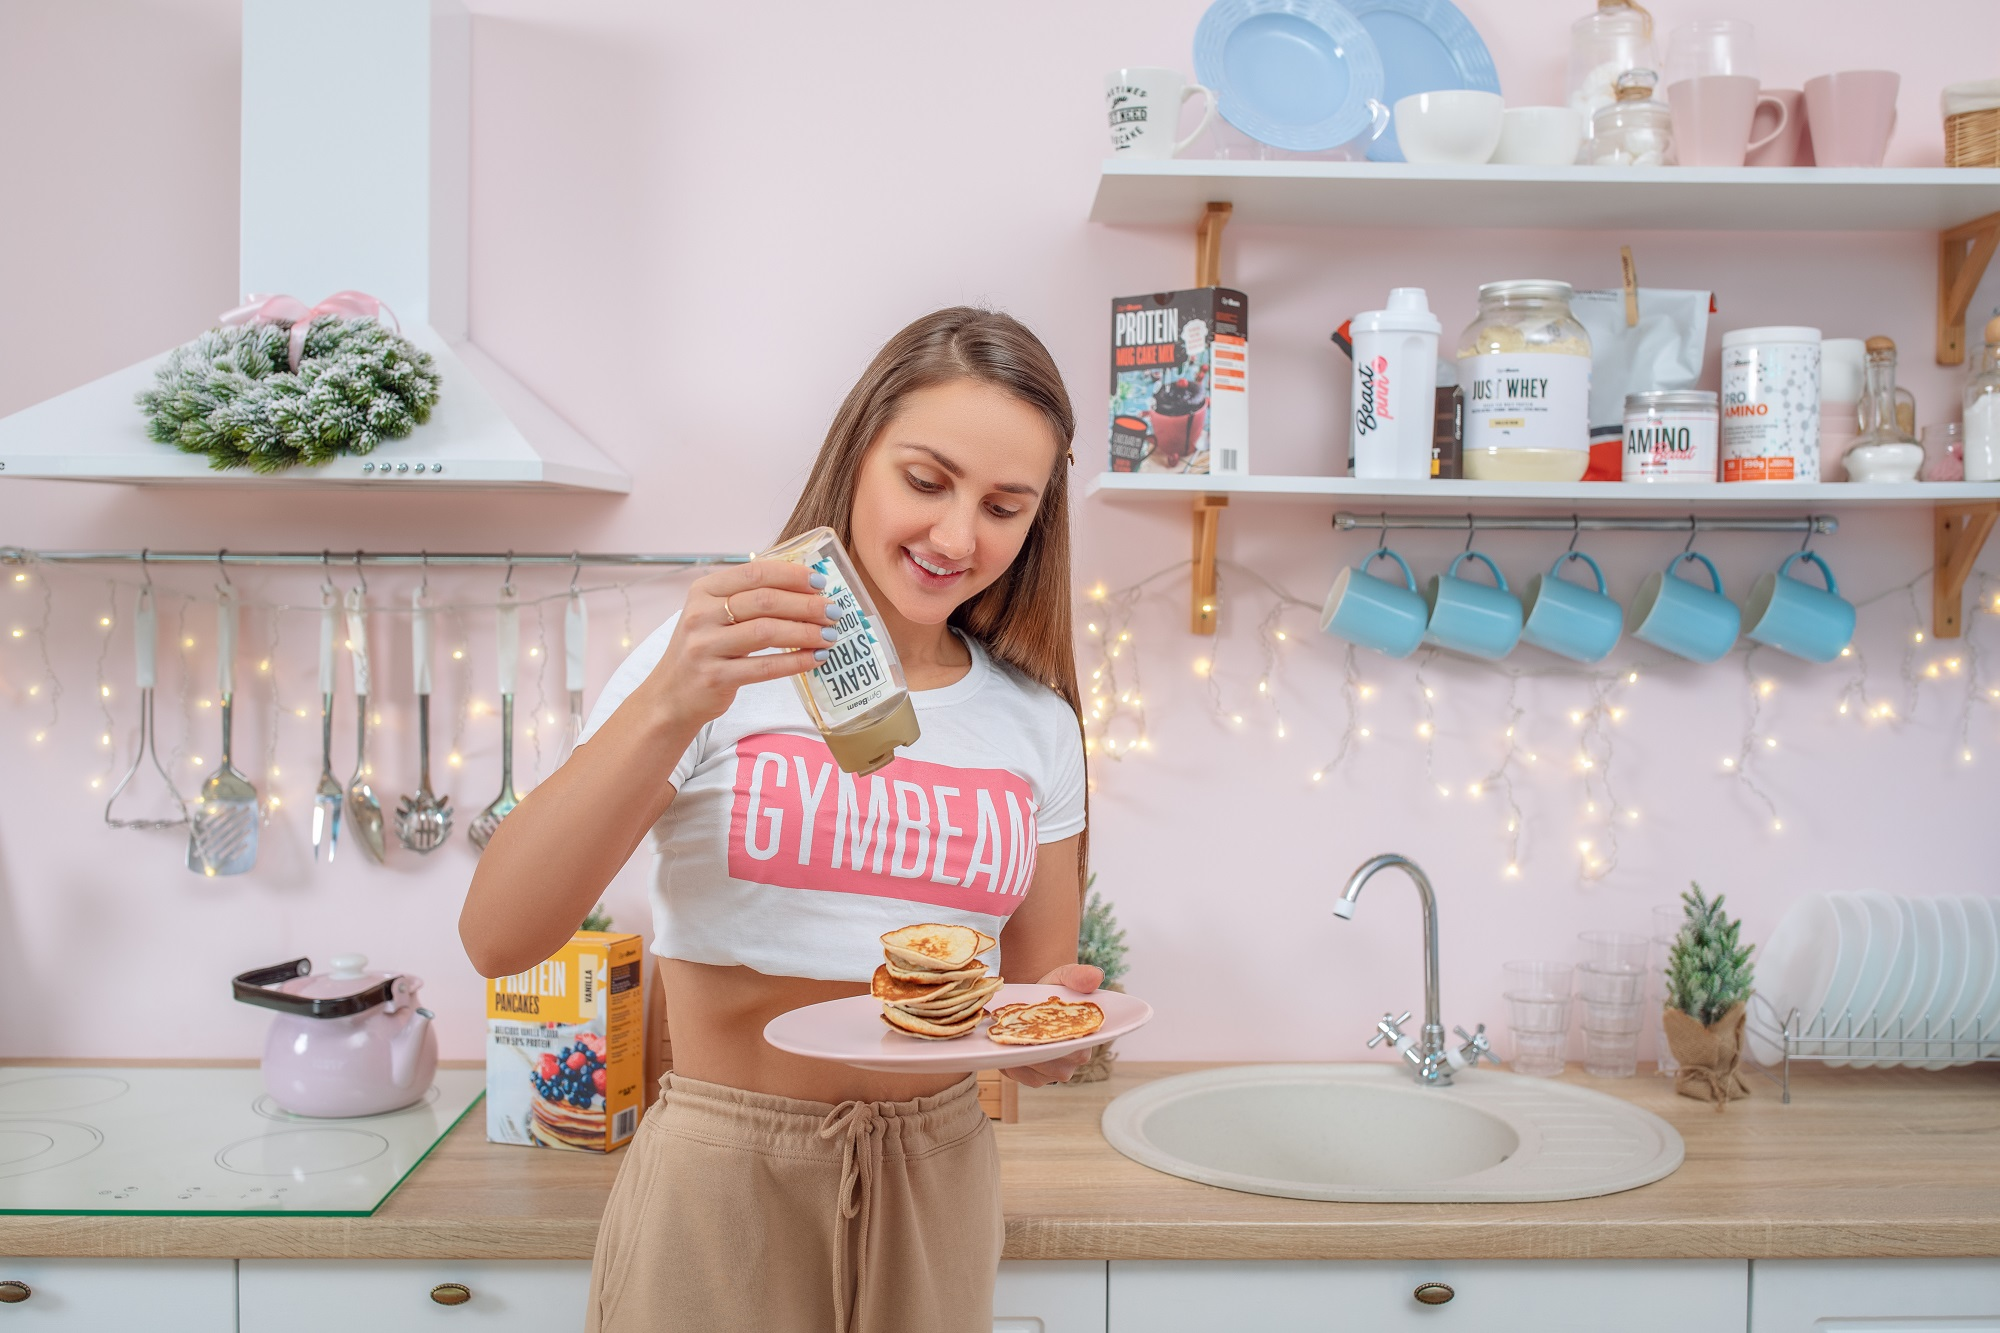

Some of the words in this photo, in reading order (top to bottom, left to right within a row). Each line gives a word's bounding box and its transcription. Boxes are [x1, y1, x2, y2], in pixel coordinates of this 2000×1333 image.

[1115, 307, 1178, 347] PROTEIN
[1356, 362, 1377, 436] Beast
[1506, 378, 1548, 398] WHEY
[1724, 403, 1768, 418] AMINO
[1627, 427, 1690, 454] AMINO
[820, 633, 872, 676] SYRUP
[826, 657, 880, 701] AGAVE
[846, 689, 882, 711] GymBeam
[744, 751, 1039, 897] GYMBEAM
[584, 969, 593, 1003] VANILLA
[495, 992, 540, 1015] PANCAKES
